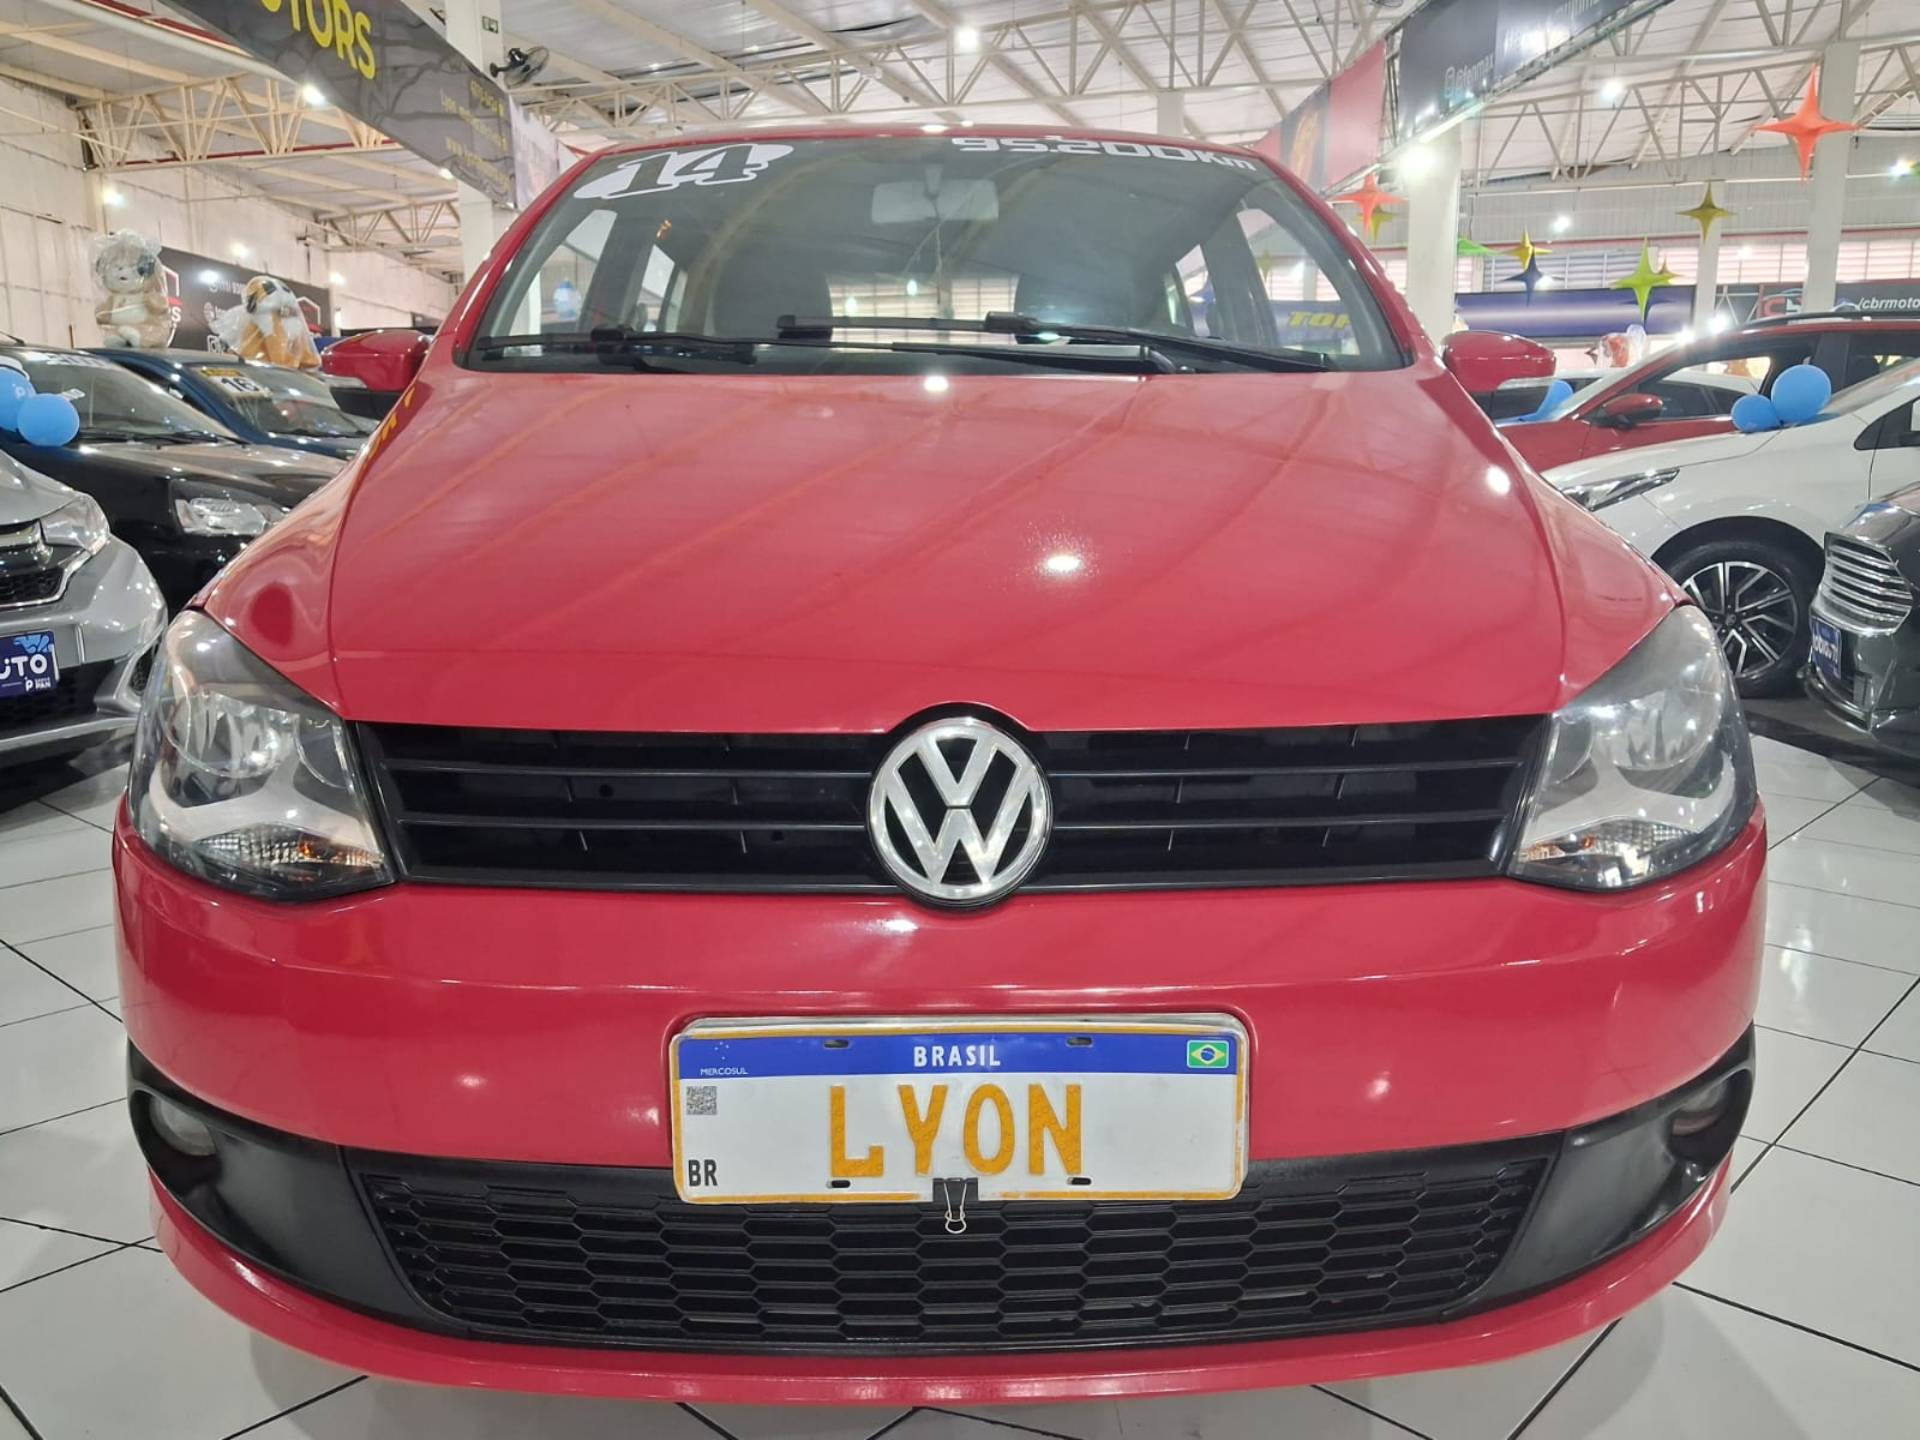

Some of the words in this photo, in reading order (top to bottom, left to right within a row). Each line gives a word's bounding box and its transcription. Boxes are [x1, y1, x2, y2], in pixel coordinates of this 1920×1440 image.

[262, 0, 376, 80] ORS
[600, 143, 769, 199] 14
[700, 1067, 749, 1077] MERCOSUL
[913, 1044, 1001, 1067] BRASIL
[829, 1083, 1082, 1178] LYON
[688, 1159, 718, 1187] BR
